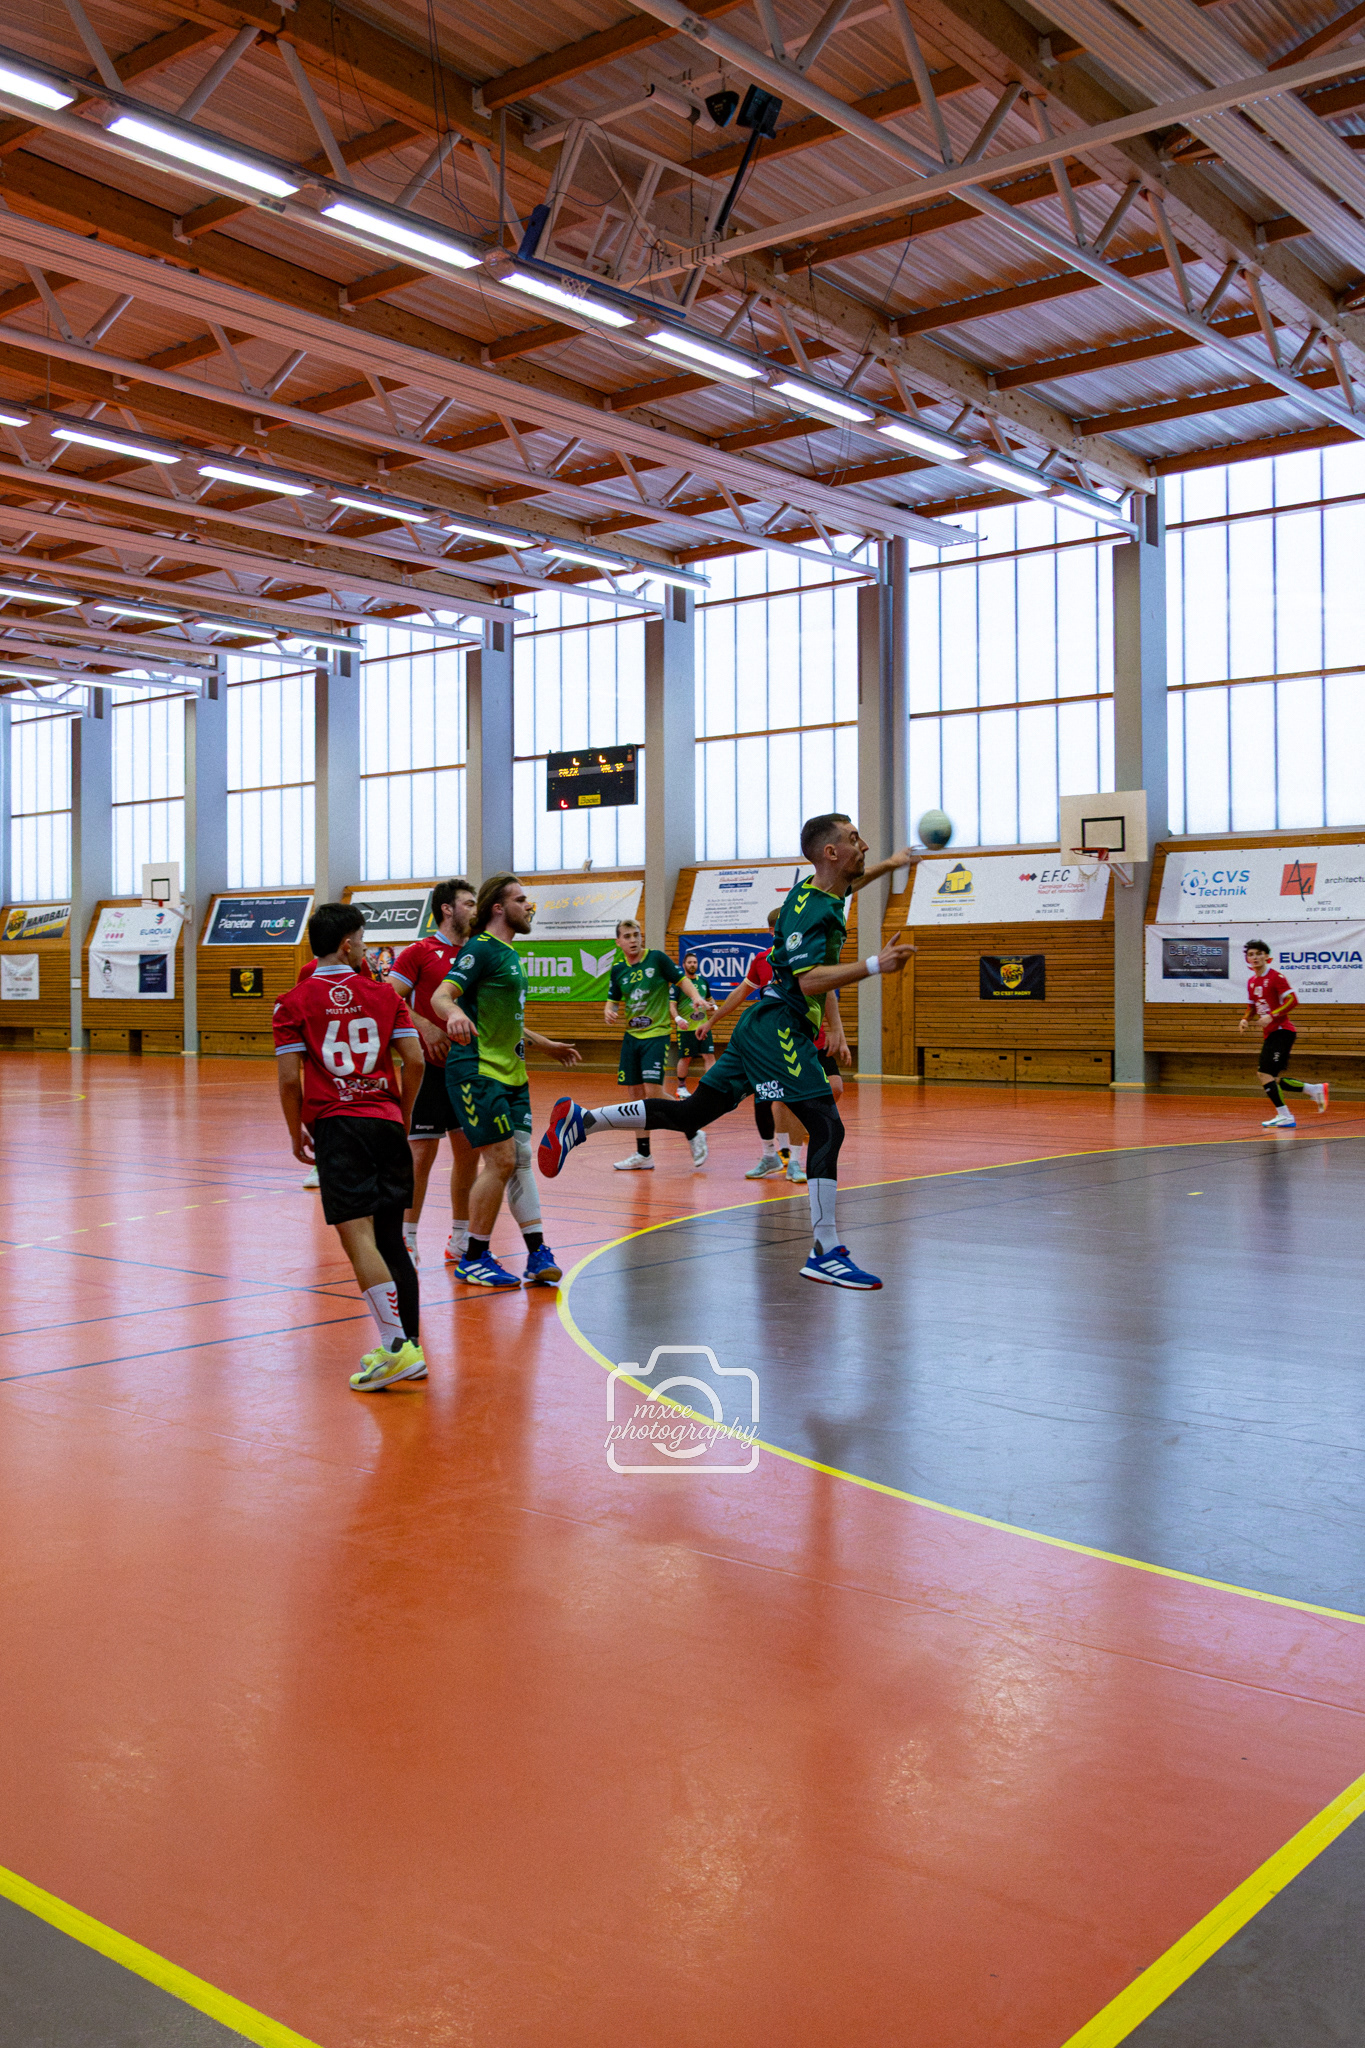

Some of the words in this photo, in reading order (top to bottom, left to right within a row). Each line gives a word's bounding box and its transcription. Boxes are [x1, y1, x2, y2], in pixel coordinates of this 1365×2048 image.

[1212, 870, 1250, 883] CVS
[1198, 886, 1247, 897] Technik
[360, 908, 419, 922] CLATEC
[1279, 951, 1362, 963] EUROVIA
[520, 952, 573, 977] rima
[694, 952, 757, 978] ORINA
[630, 970, 643, 983] 23
[326, 1005, 362, 1015] MUTANT
[322, 1017, 381, 1076] 69
[618, 1070, 625, 1082] 3
[493, 1114, 511, 1134] 11
